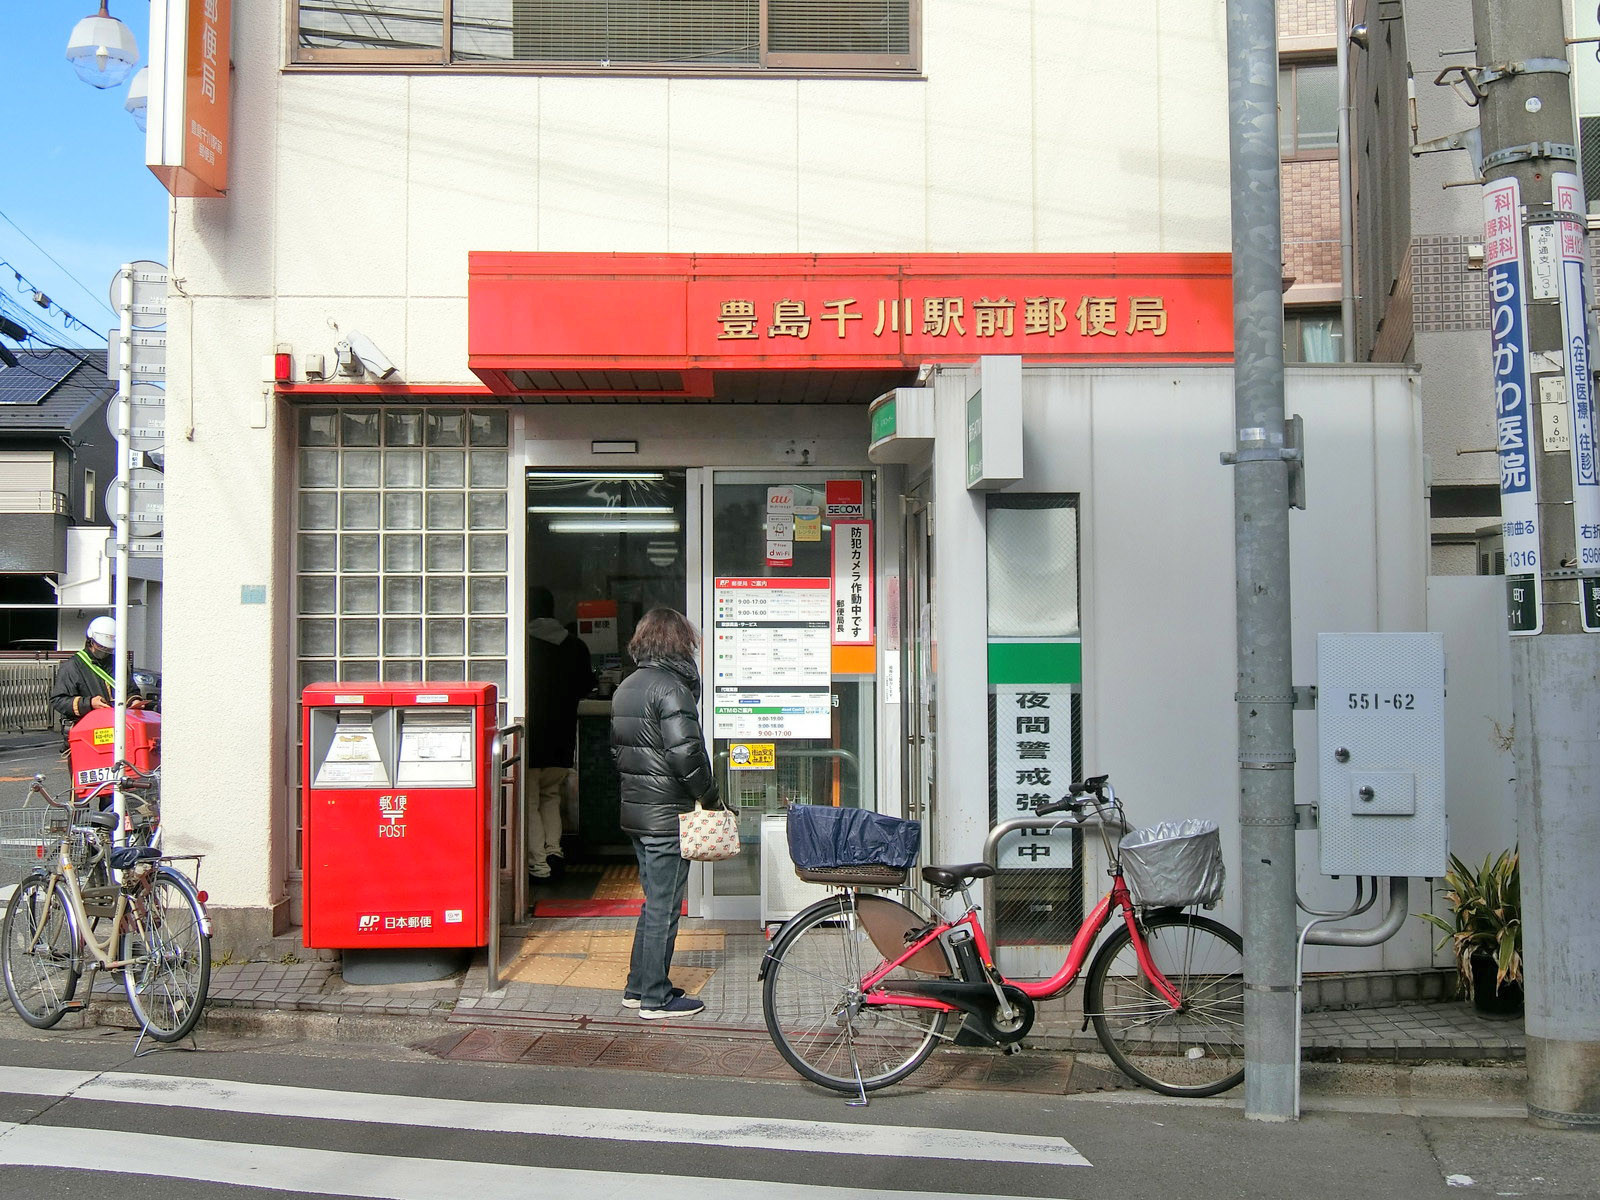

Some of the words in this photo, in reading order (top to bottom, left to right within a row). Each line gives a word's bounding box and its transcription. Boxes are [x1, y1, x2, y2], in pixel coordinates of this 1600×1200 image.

[1561, 191, 1573, 210] 内
[1484, 214, 1512, 240] 器科
[1486, 236, 1514, 261] 器科
[717, 296, 1169, 340] 豊島千川駅前郵便局
[1489, 269, 1527, 491] もりかわ医院
[770, 495, 791, 504] au
[828, 505, 862, 514] SECOM
[850, 527, 863, 638] 防犯カメラ作動中です
[1512, 587, 1525, 604] 町
[836, 599, 845, 633] 郵便局長
[1348, 693, 1415, 710] 551-62
[379, 795, 408, 811] 郵便
[379, 824, 407, 838] POST
[384, 915, 432, 929] 日本郵便
